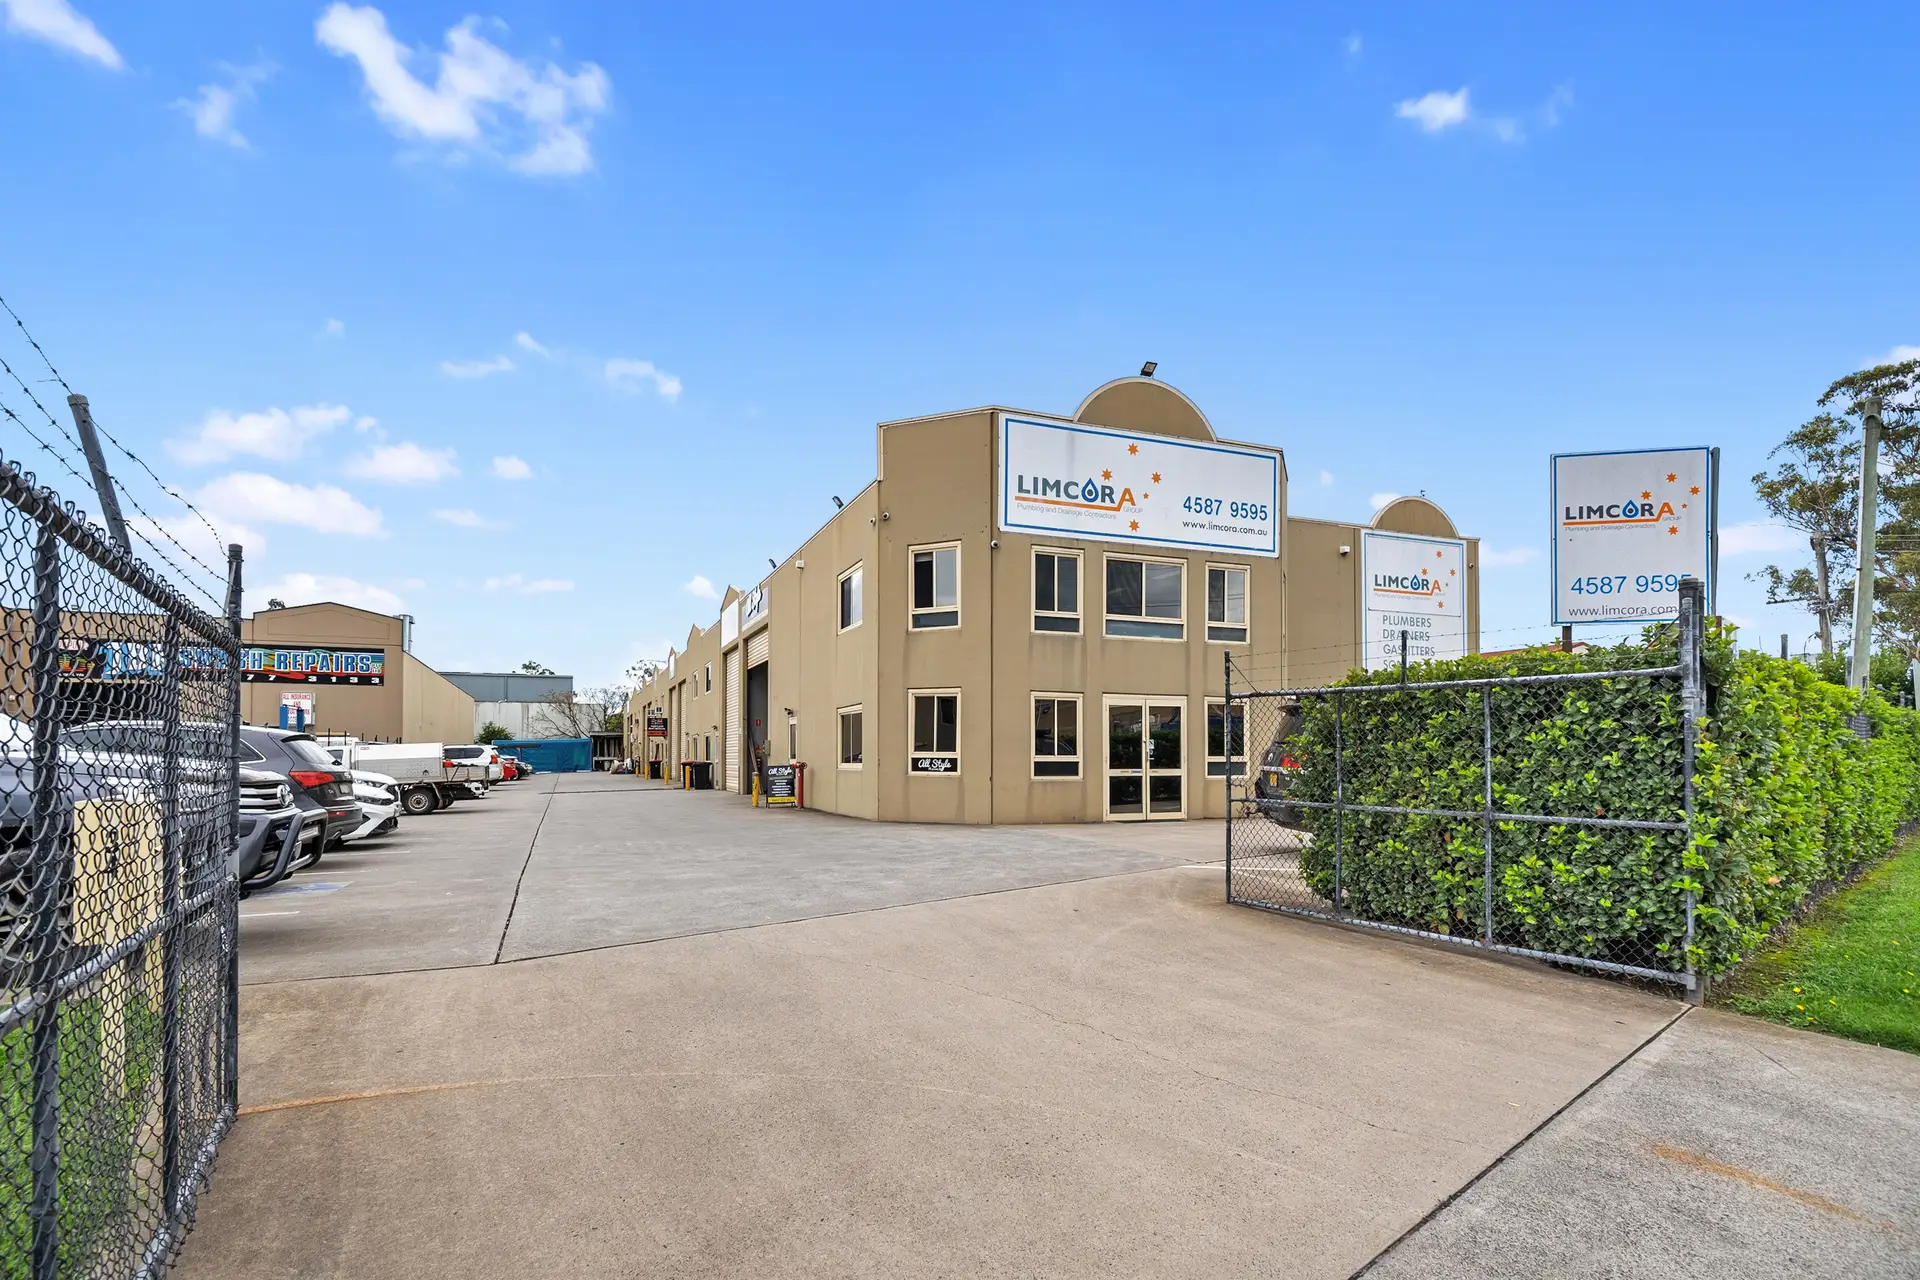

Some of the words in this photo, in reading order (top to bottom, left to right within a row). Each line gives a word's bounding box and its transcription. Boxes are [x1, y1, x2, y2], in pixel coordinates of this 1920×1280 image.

[1017, 474, 1136, 507] LIMCORA
[1016, 503, 1044, 514] Plumbing
[1045, 506, 1057, 514] and
[1057, 507, 1083, 517] Drainage
[1084, 510, 1117, 520] Contractors
[1183, 496, 1222, 515] 4587
[1230, 501, 1268, 521] 9595
[1565, 500, 1675, 520] LIMCORA
[1182, 521, 1268, 536] www.limcora.com.au
[1564, 525, 1589, 533] Plumbing
[1374, 574, 1441, 592] LIMCORA
[1571, 576, 1627, 594] 4587
[1635, 574, 1692, 593] 959
[1382, 614, 1432, 628] PLUMBERS
[1382, 629, 1430, 641] DRANERS
[1383, 644, 1436, 657] GASITTERS
[275, 651, 371, 674] REPAIRS
[918, 759, 931, 768] All
[931, 759, 952, 771] Style
